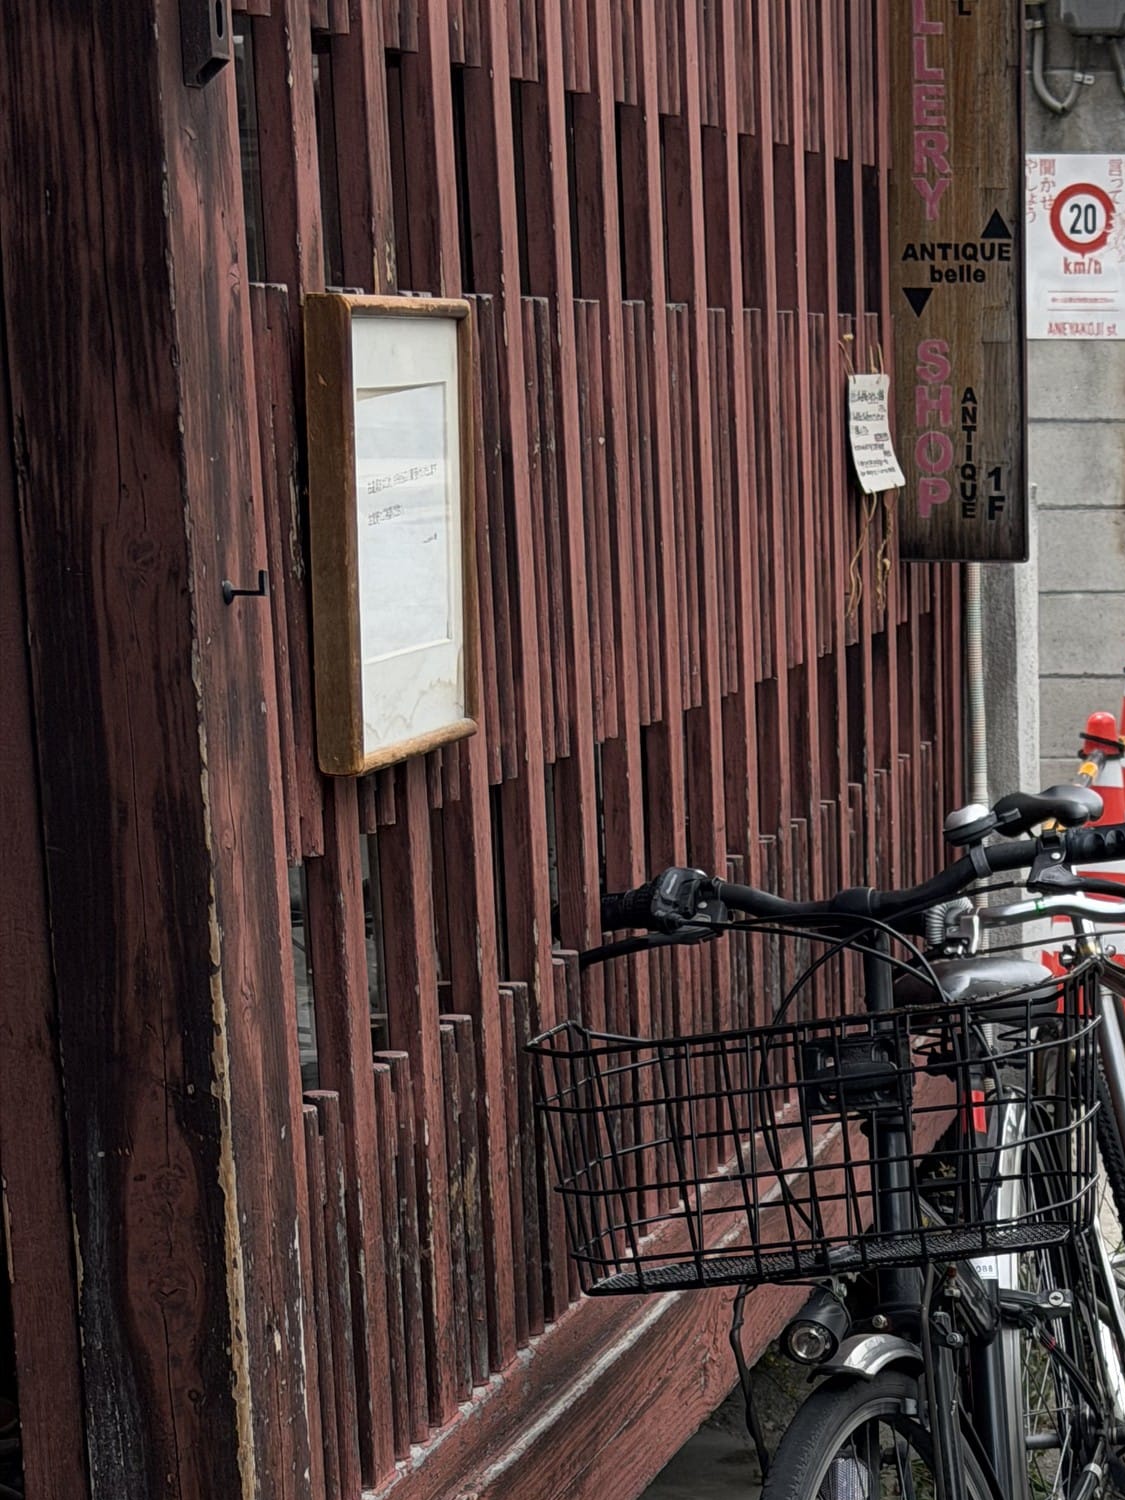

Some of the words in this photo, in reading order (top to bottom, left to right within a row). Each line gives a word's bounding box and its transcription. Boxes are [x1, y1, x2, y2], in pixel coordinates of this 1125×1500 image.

[1069, 203, 1097, 235] 20
[902, 243, 1012, 262] ANTIQUE
[930, 265, 986, 283] belle
[1063, 256, 1102, 275] km/h
[915, 338, 953, 519] SHOP
[960, 386, 978, 519] ANTIQUE
